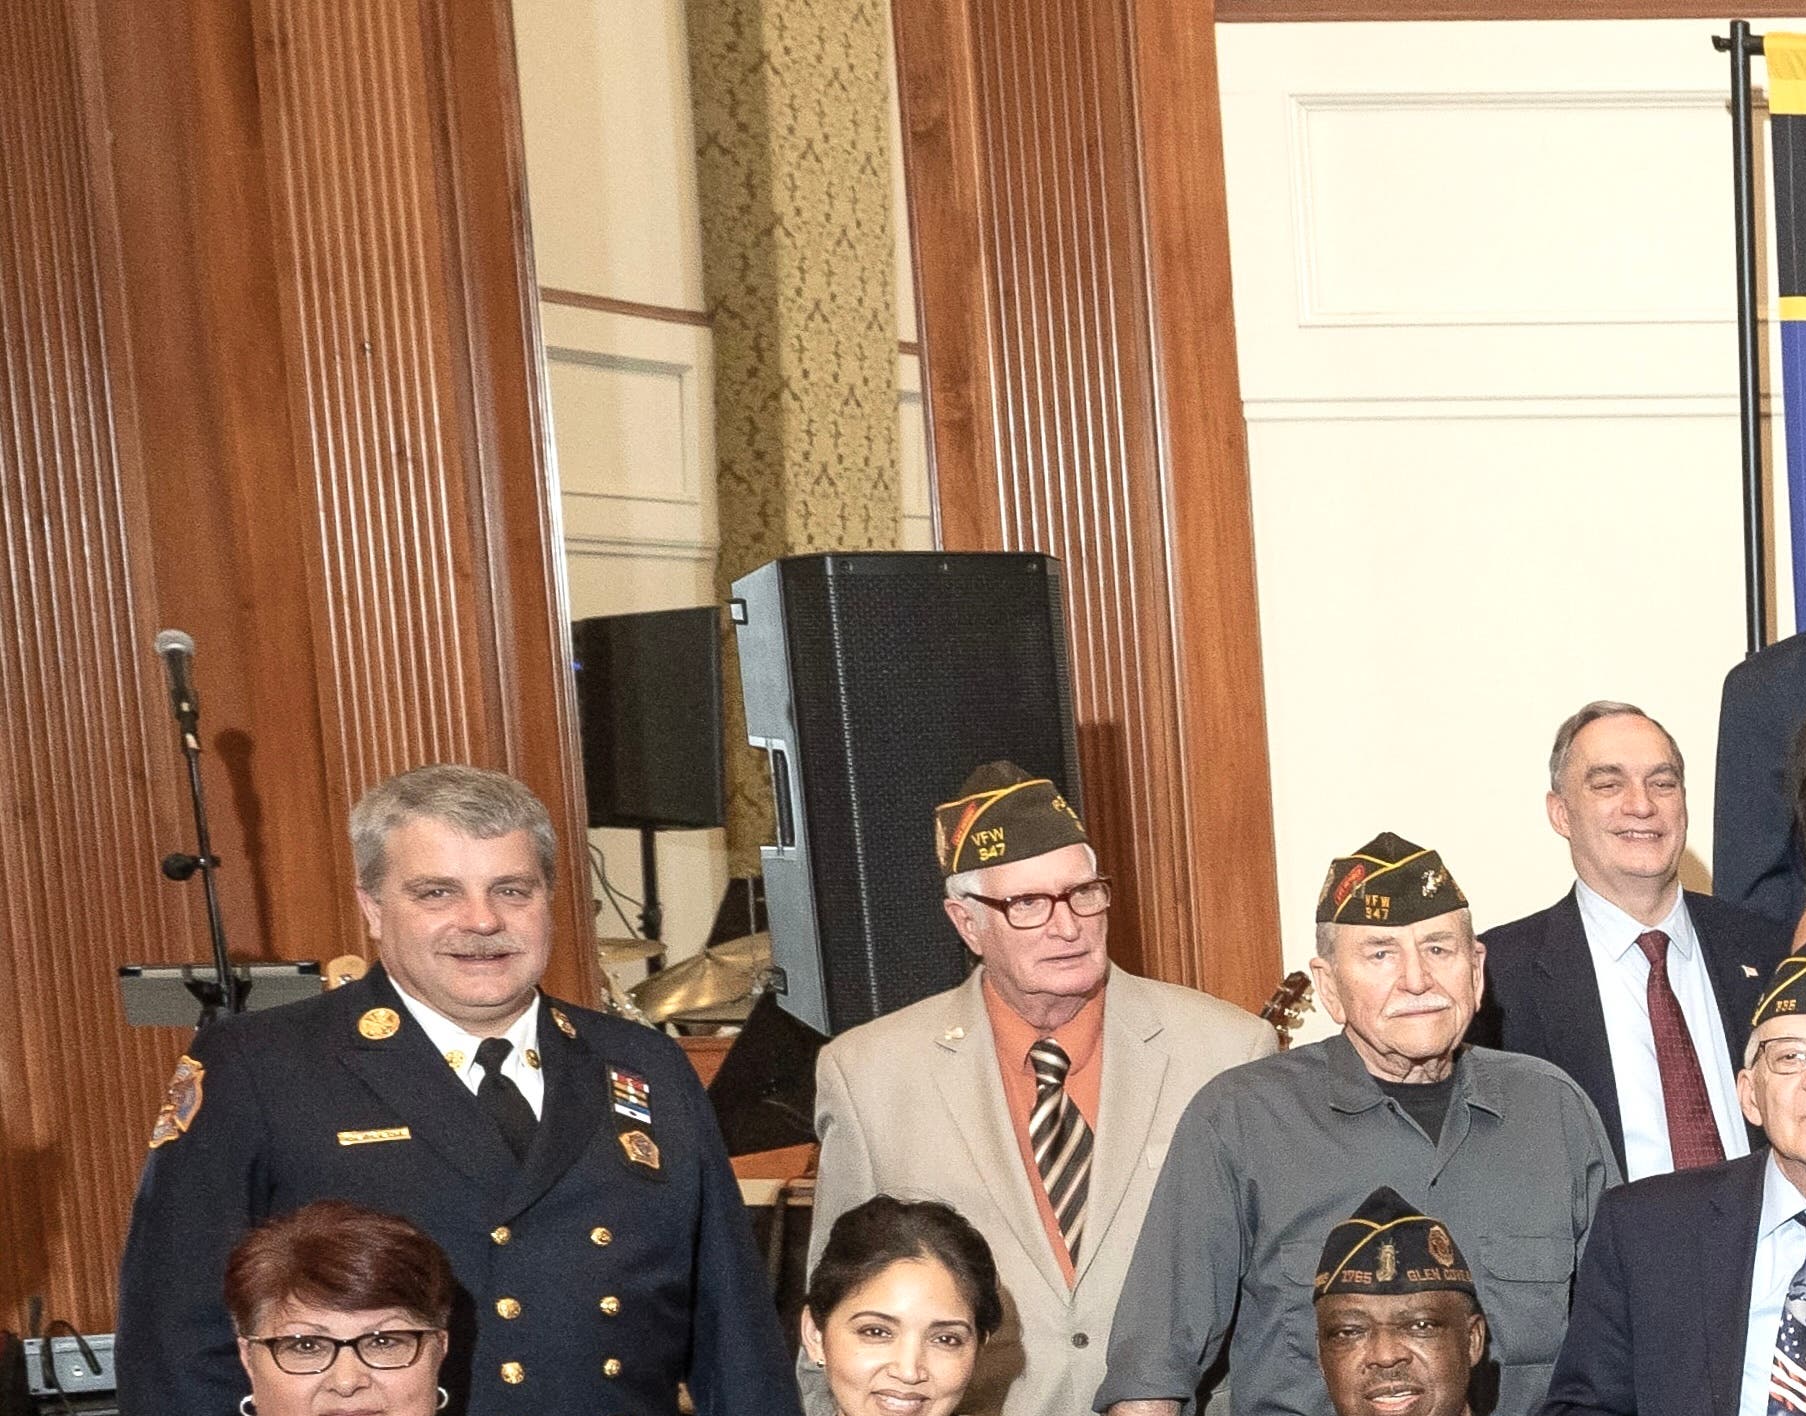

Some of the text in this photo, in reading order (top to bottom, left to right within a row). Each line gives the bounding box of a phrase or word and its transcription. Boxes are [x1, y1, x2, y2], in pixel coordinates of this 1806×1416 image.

[972, 827, 1004, 846] VFW
[979, 843, 1005, 861] 347
[1365, 895, 1391, 908] VFW
[1365, 908, 1389, 920] 347
[1407, 1268, 1441, 1282] GLEN
